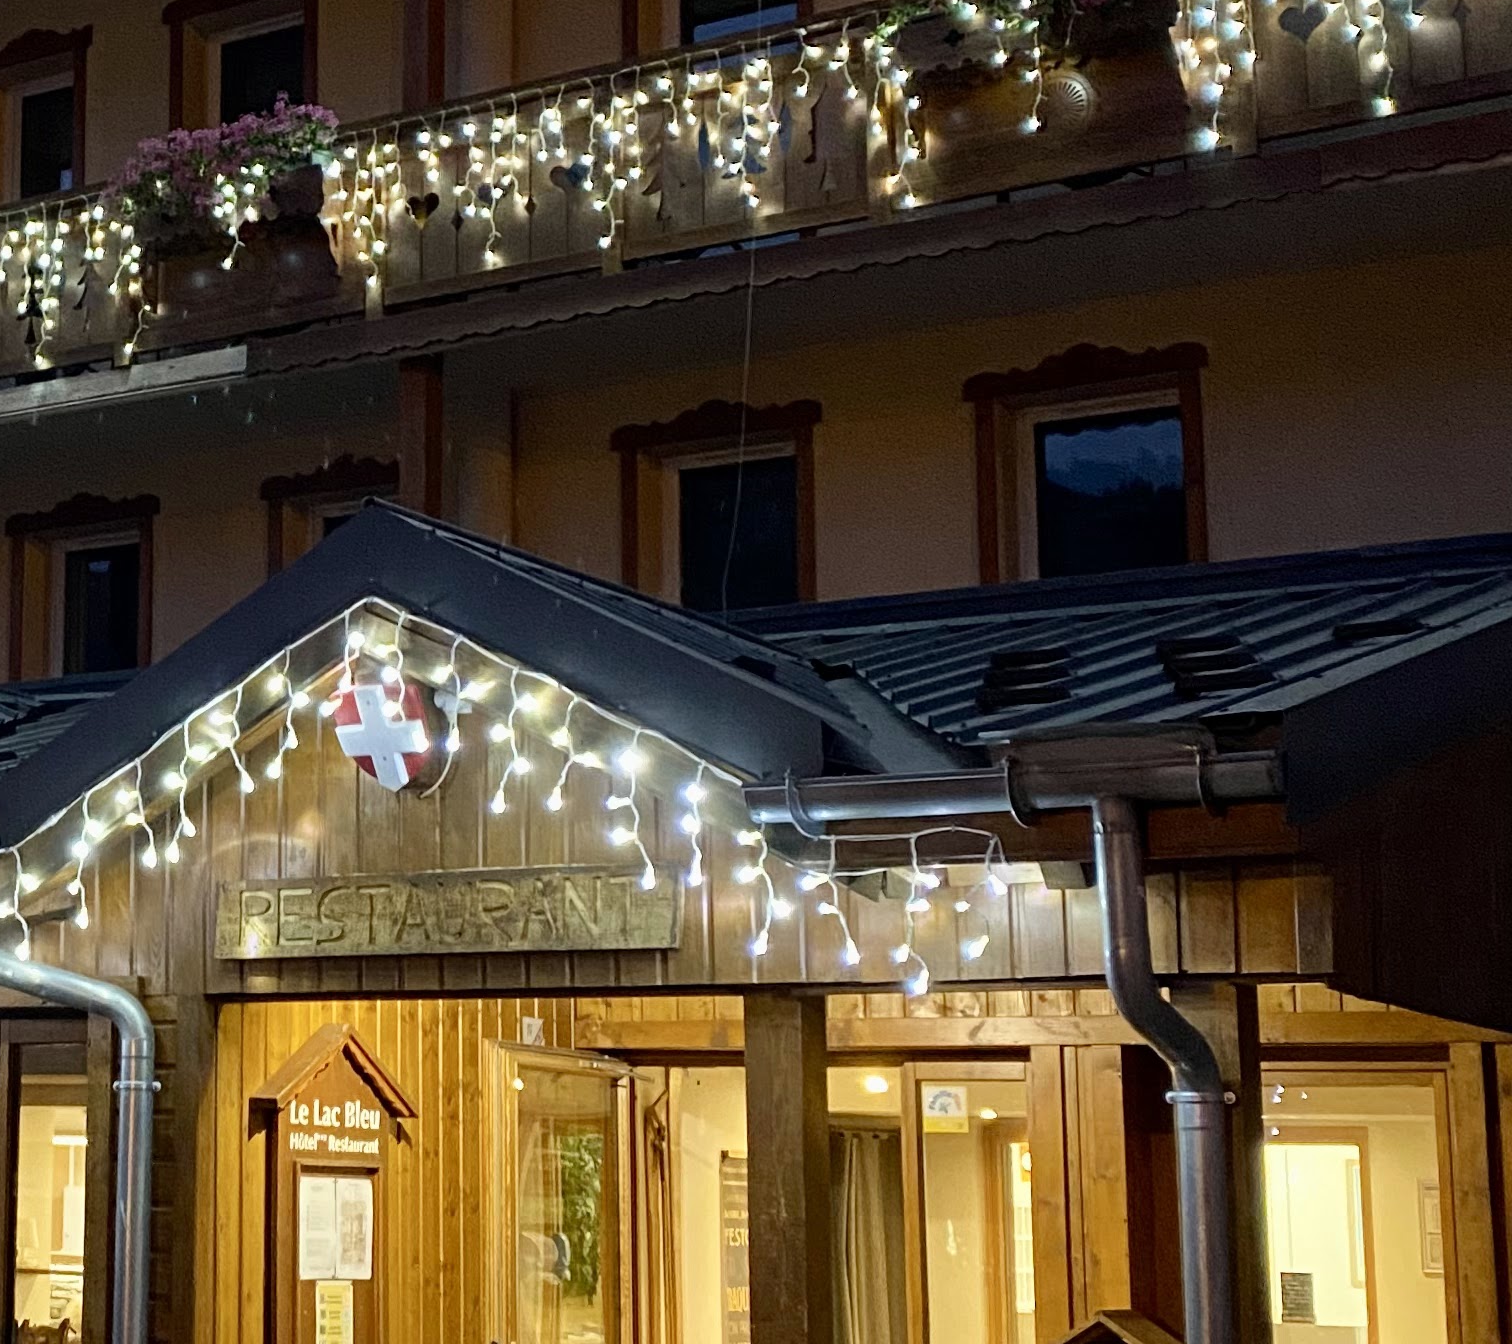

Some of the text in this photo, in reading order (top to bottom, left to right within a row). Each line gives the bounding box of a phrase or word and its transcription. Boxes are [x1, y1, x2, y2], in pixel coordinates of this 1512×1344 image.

[239, 876, 639, 947] RESTAURANT
[289, 1099, 381, 1130] Le Lac Bleu
[328, 1134, 380, 1154] Restaurant
